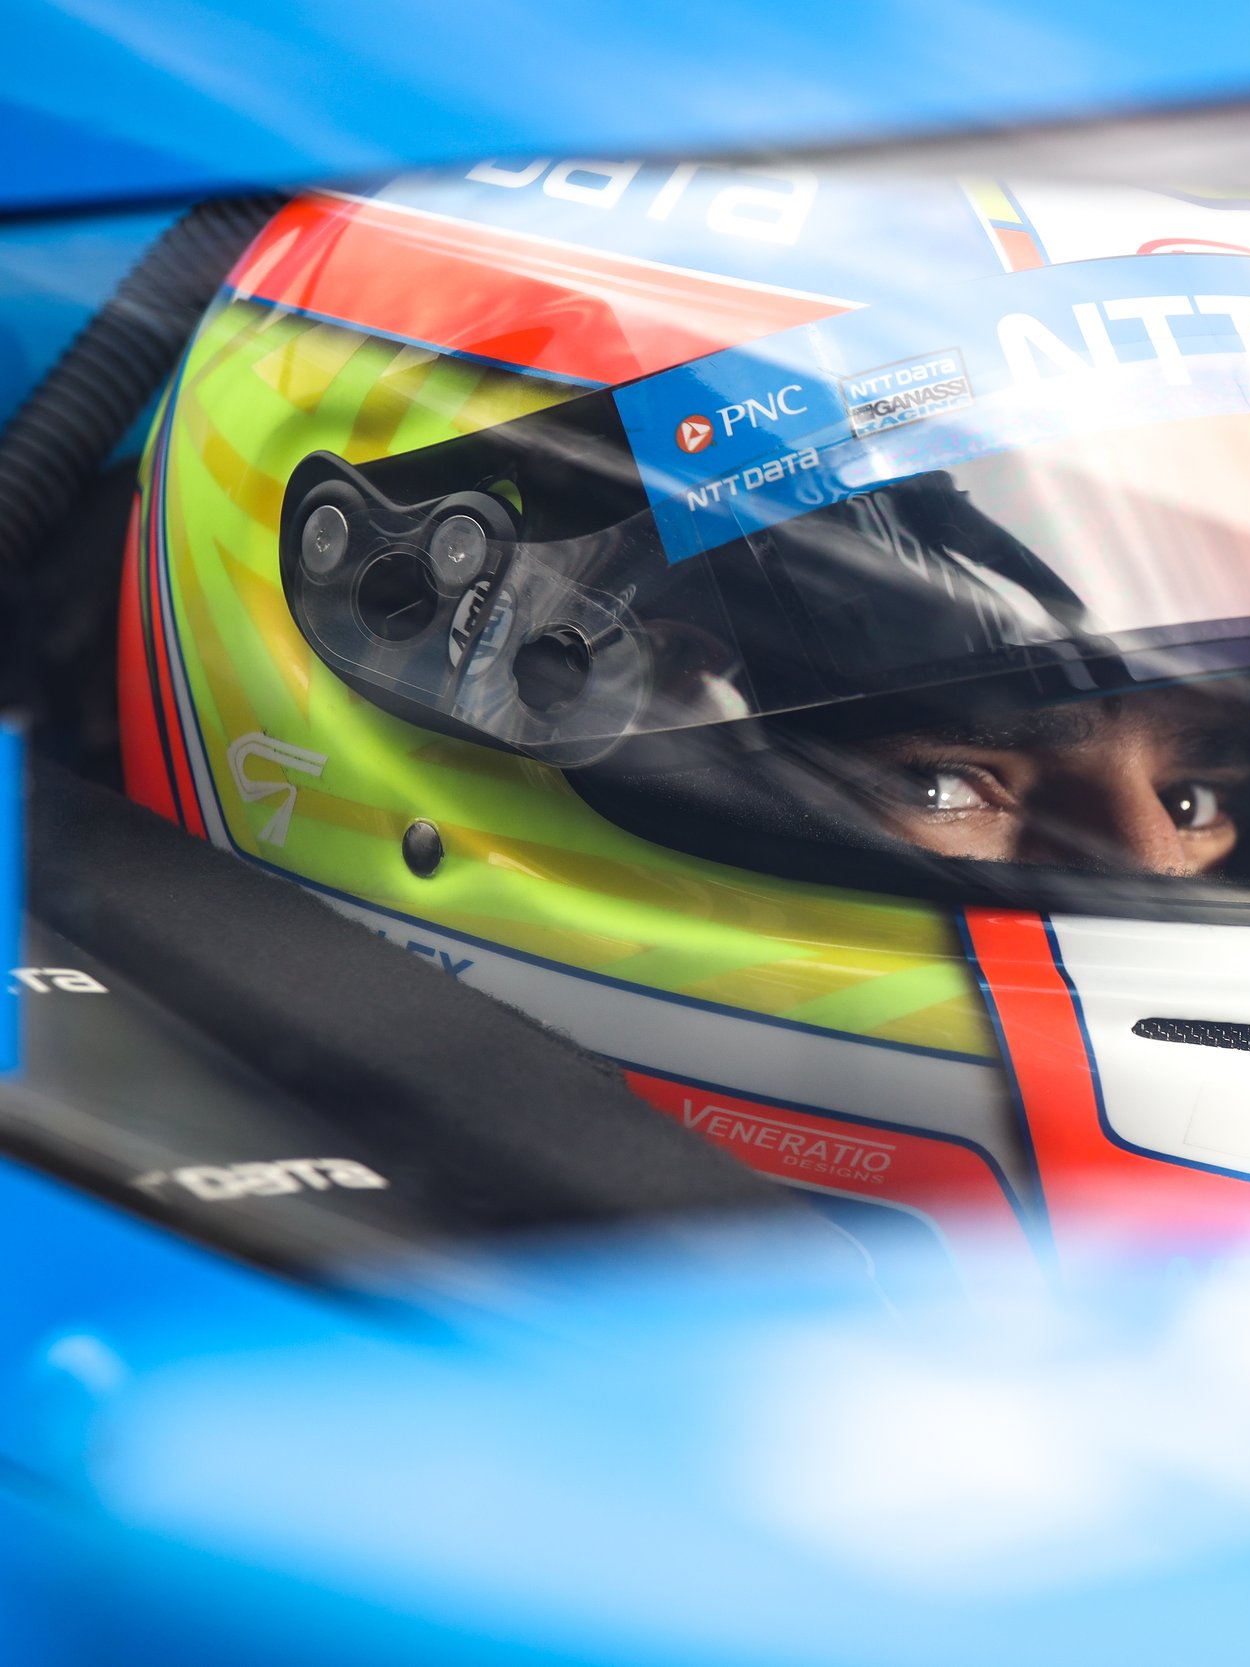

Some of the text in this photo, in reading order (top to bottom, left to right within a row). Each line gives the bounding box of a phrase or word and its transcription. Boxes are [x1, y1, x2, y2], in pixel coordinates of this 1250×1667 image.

[850, 373, 893, 400] NTT
[716, 384, 808, 437] PNC
[686, 474, 740, 512] NTT
[684, 1099, 896, 1173] VENERATIO
[783, 1154, 885, 1185] DESIGNS
